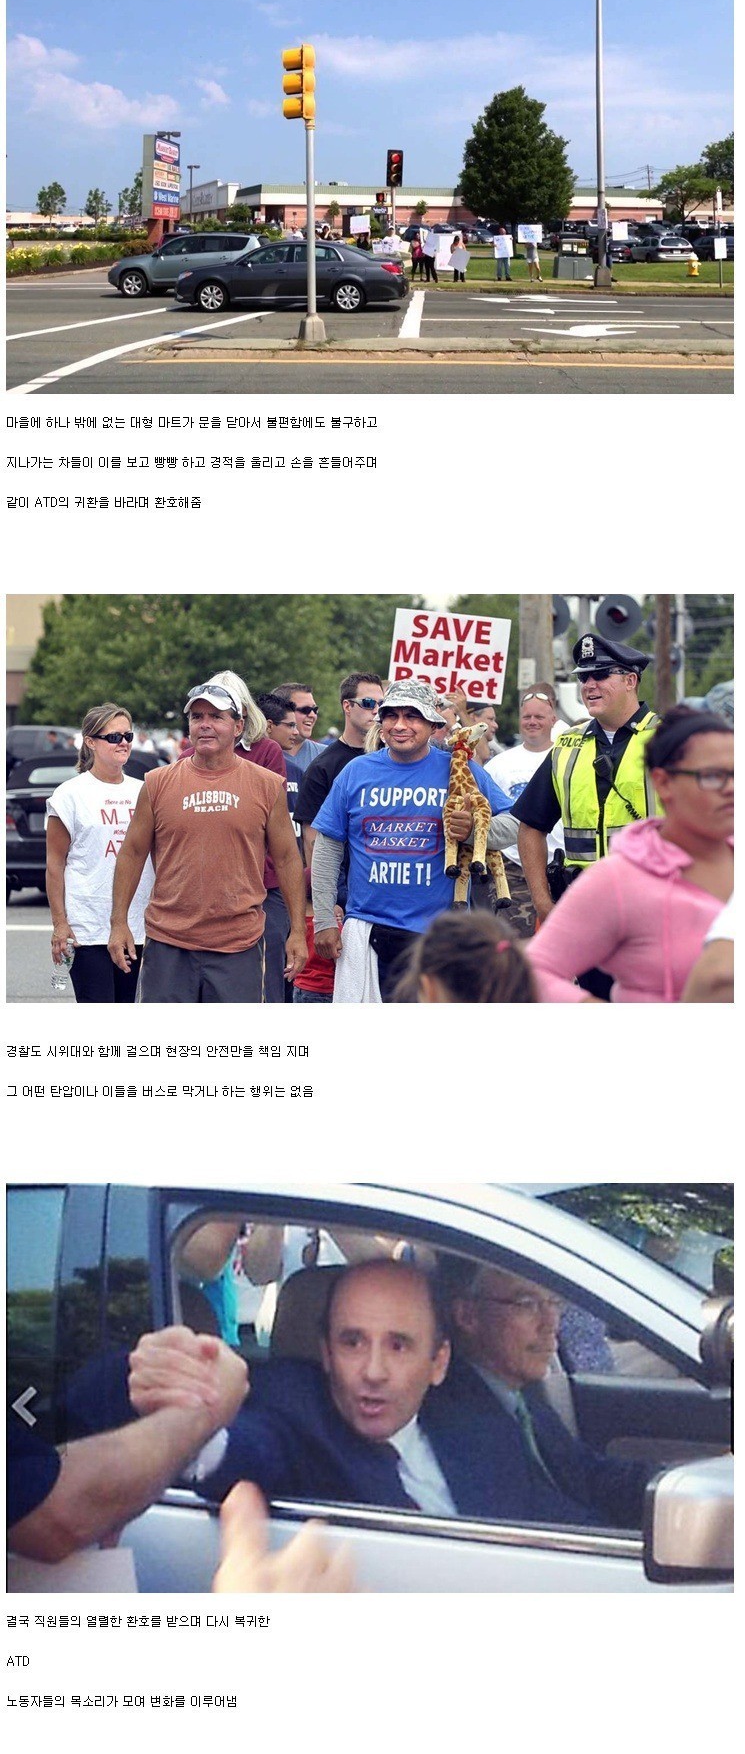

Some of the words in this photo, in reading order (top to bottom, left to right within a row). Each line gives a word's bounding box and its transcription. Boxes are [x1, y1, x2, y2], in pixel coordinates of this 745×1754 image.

[412, 614, 492, 645] SAVE
[393, 639, 504, 673] Market
[394, 666, 498, 700] Basket
[559, 737, 586, 748] POLICE
[182, 790, 240, 811] SALISBURY
[360, 788, 364, 807] I
[369, 787, 447, 807] SUPPORT
[194, 804, 228, 813] BEACH
[370, 821, 436, 833] MARKET
[370, 837, 429, 848] BASKET
[369, 861, 413, 884] ARTIE
[416, 862, 431, 886] T!
